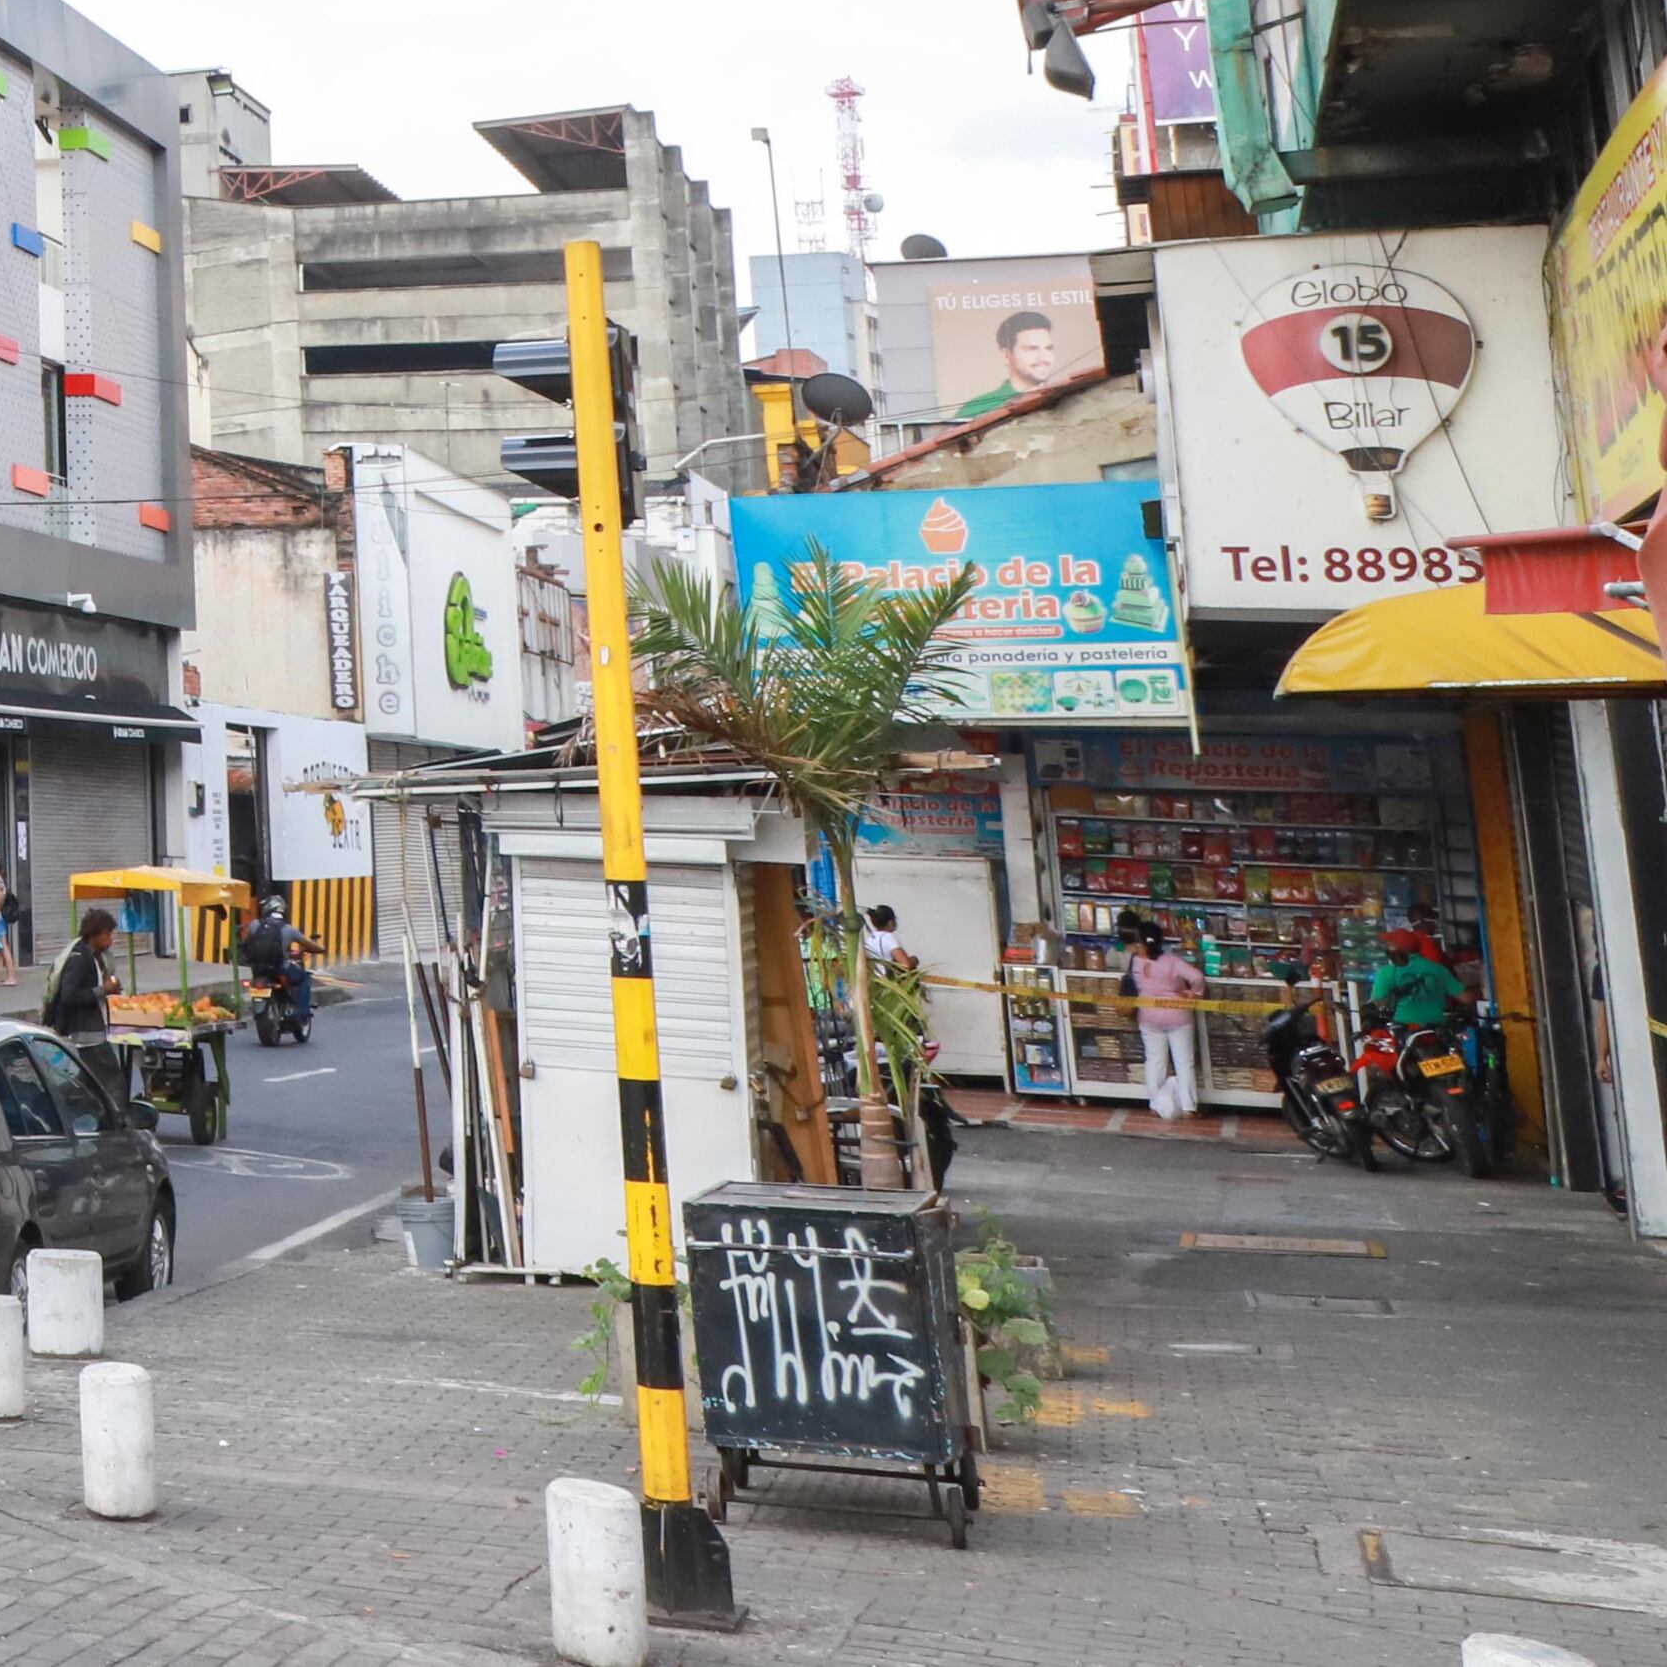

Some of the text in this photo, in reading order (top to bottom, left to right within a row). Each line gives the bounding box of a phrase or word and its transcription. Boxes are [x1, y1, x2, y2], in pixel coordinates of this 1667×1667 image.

[1172, 25, 1198, 51] Y
[935, 293, 956, 310] TÚ
[962, 293, 1021, 309] ELIGES
[1027, 292, 1047, 307] EL
[1291, 276, 1408, 306] Globo
[1330, 325, 1388, 362] 15
[1323, 402, 1411, 430] Billar
[997, 556, 1051, 587] de
[1058, 554, 1101, 586] la
[1220, 545, 1485, 583] Tel: 88985
[328, 572, 355, 709] PARQUEADERO
[26, 637, 98, 682] COMERCIO
[969, 648, 1059, 670] panadería
[1064, 651, 1074, 669] y
[1080, 646, 1168, 668] pastelería
